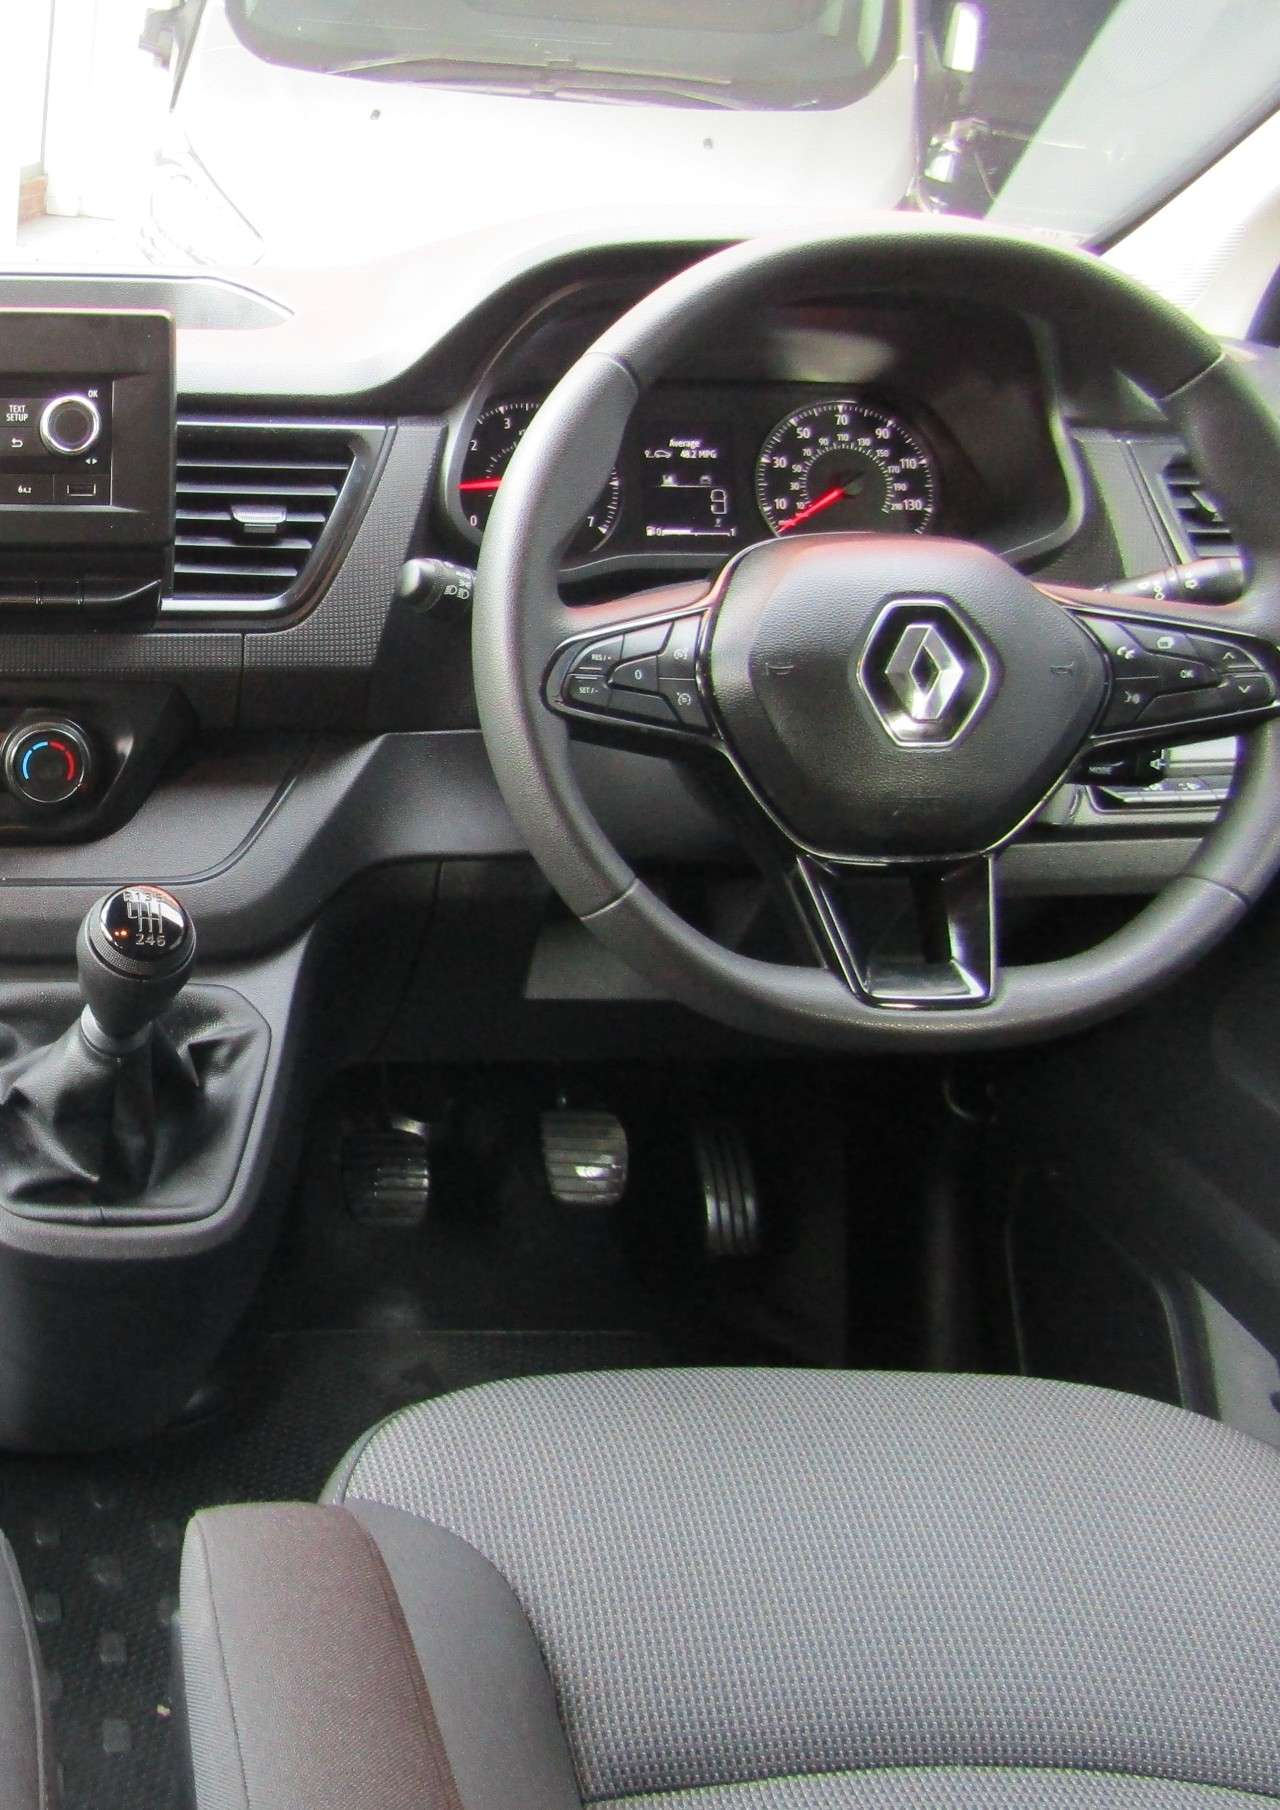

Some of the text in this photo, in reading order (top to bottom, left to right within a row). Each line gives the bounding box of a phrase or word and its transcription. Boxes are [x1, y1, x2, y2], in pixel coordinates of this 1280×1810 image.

[88, 390, 98, 398] OK
[9, 405, 26, 413] TEXT
[6, 414, 28, 422] SETUP
[504, 418, 511, 429] 3
[834, 414, 849, 426] 70
[796, 426, 811, 439] 50
[836, 434, 849, 442] 110
[875, 427, 890, 440] 90
[470, 440, 478, 451] 2
[669, 438, 701, 450] Average
[698, 450, 717, 459] MPG
[802, 448, 812, 456] 70
[773, 456, 787, 469] 30
[900, 458, 918, 470] 110
[774, 498, 788, 510] 10
[903, 498, 922, 511] 130
[470, 515, 478, 526] 0
[587, 516, 595, 528] 7
[1180, 670, 1194, 678] OK
